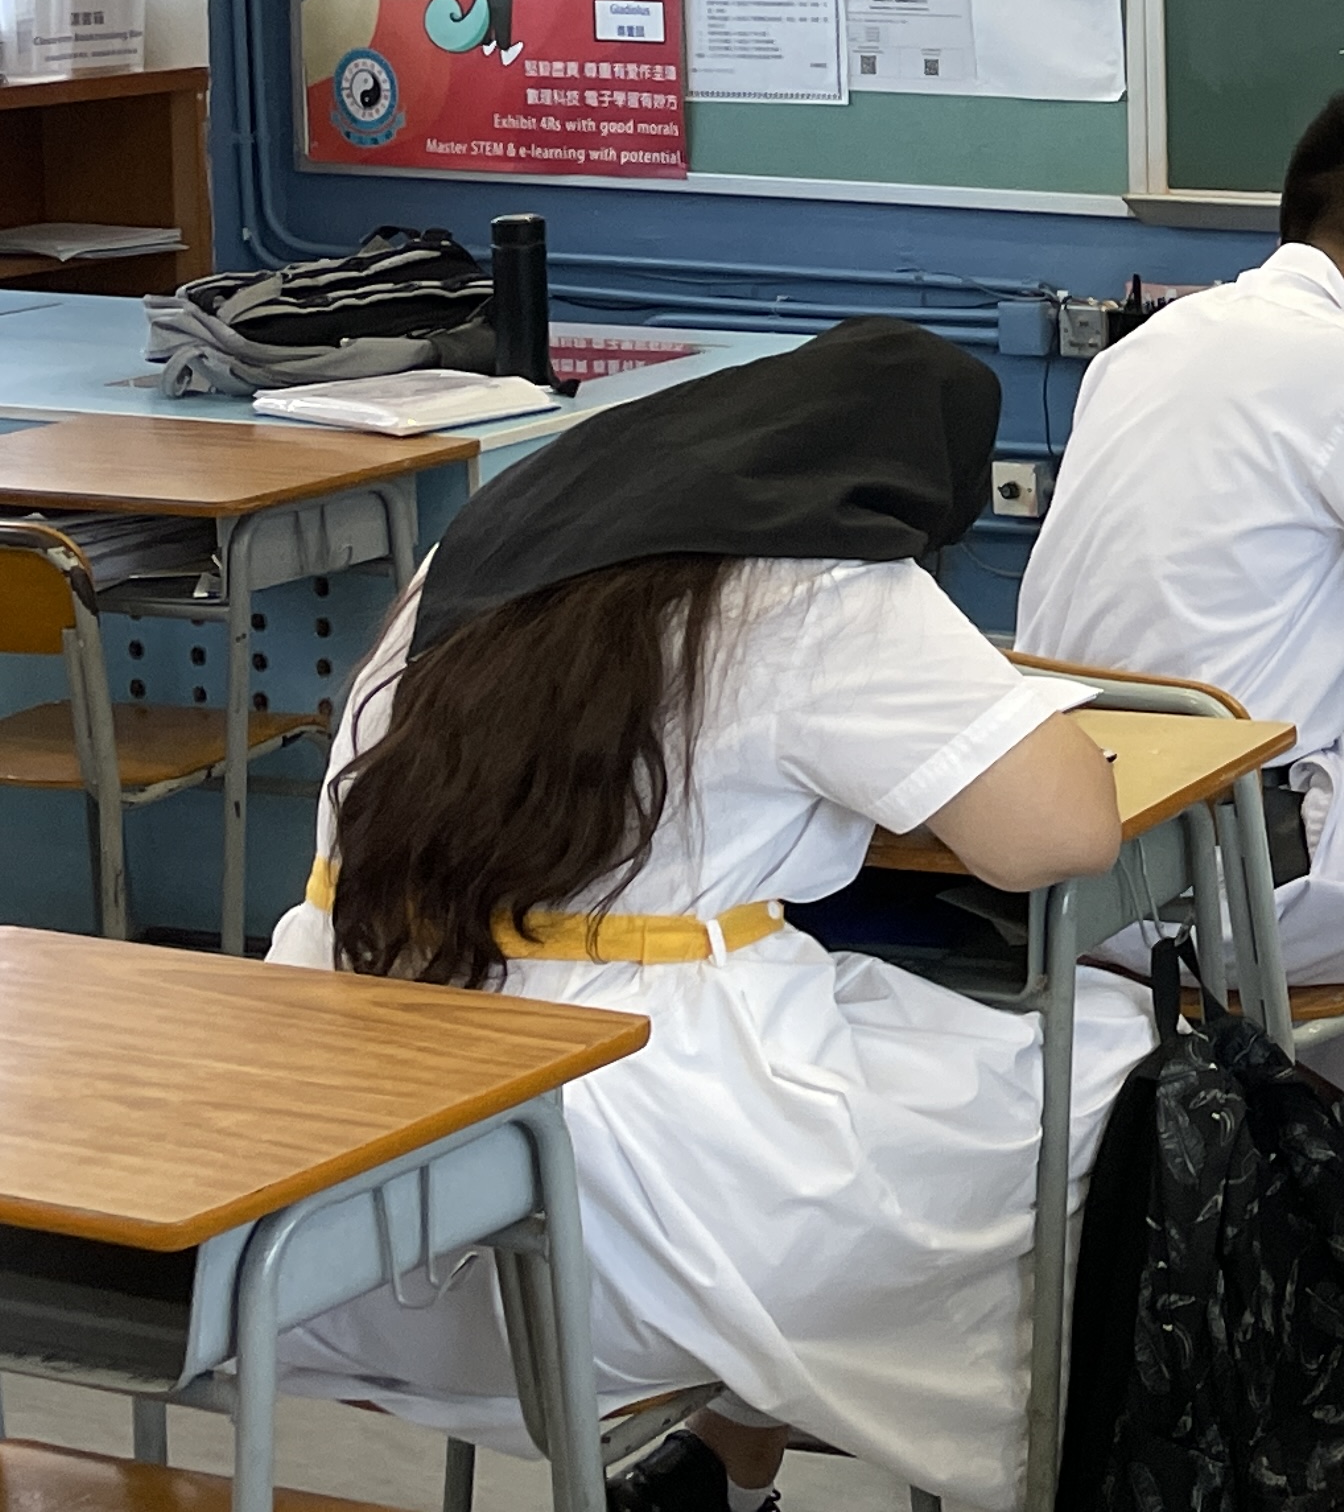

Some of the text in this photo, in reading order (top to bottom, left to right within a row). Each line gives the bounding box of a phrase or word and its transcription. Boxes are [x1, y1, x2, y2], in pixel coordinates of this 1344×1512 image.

[493, 113, 680, 137] Exhibit 4Rs with good morals
[425, 138, 468, 154] Master
[470, 139, 504, 156] STEM
[506, 141, 516, 158] &
[518, 143, 585, 164] e-learning
[588, 146, 617, 162] with
